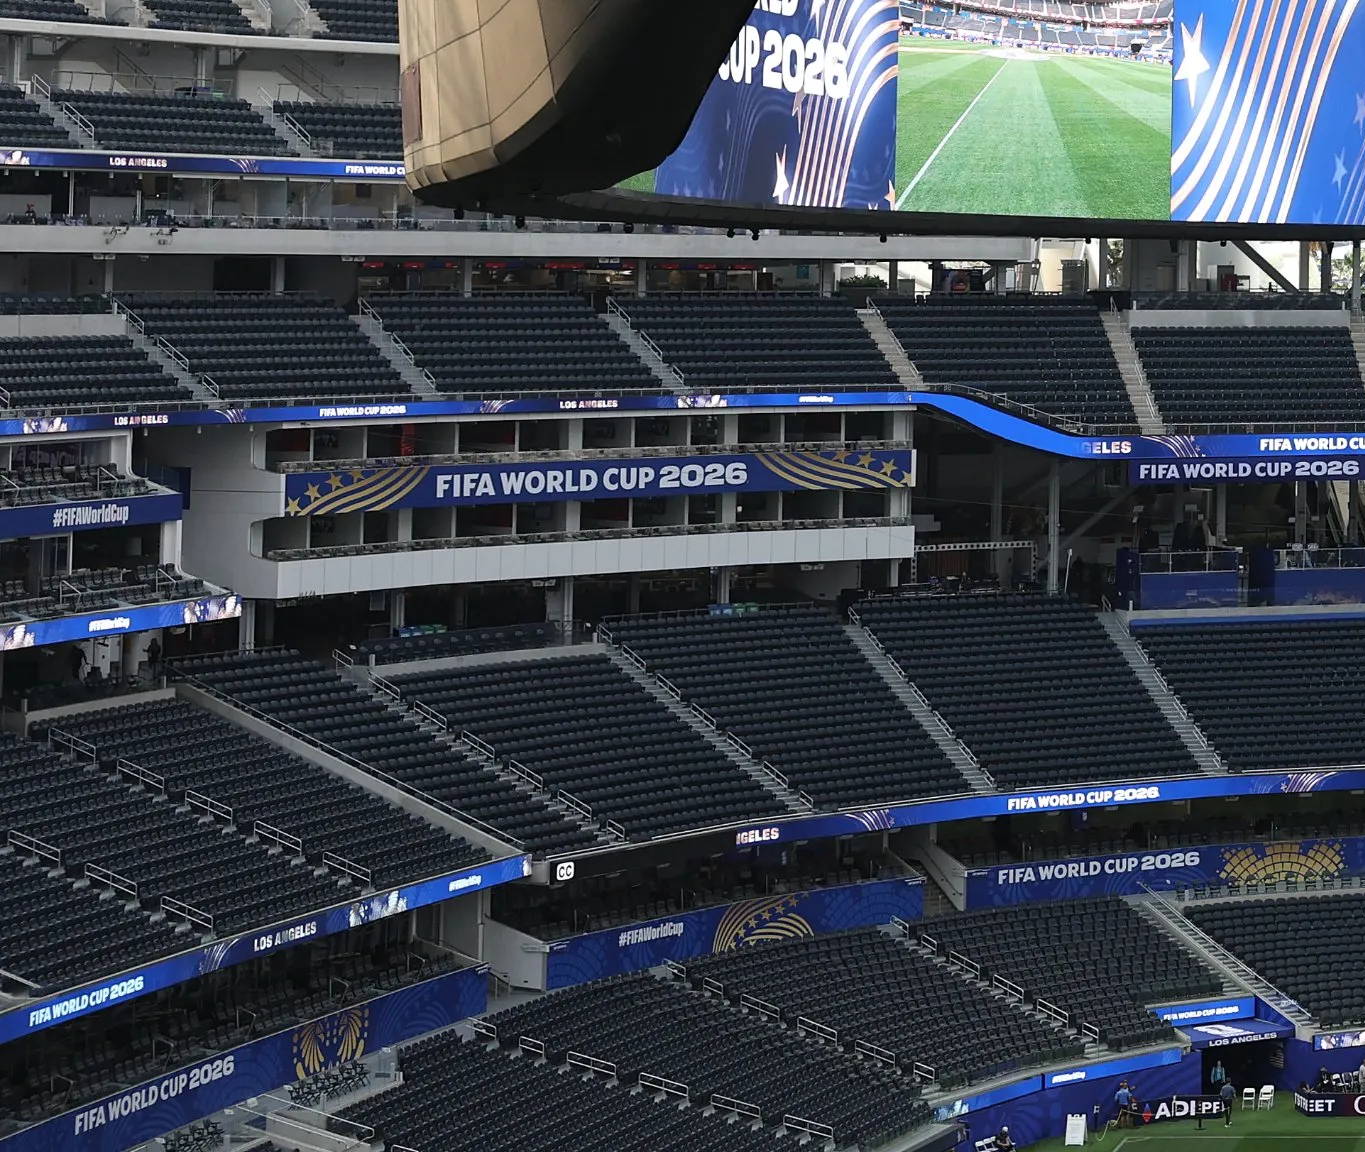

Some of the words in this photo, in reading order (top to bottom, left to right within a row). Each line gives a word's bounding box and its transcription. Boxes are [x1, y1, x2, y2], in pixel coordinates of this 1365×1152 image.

[762, 29, 848, 99] 2026
[109, 156, 126, 167] LOS
[128, 157, 168, 168] ANGELES
[345, 165, 364, 174] FIFA
[364, 166, 396, 175] WORLD
[560, 401, 578, 409] LOS
[580, 399, 618, 408] ANGELES
[114, 417, 128, 426] LOS
[129, 415, 168, 425] ANGELES
[1260, 437, 1291, 451] FIFA
[1294, 437, 1346, 451] WORLD
[436, 472, 495, 498] FIFA
[500, 469, 597, 495] WORLD
[602, 466, 655, 492] CUP
[659, 463, 748, 488] 2026
[1139, 463, 1179, 480] FIFA
[1183, 462, 1251, 479] WORLD
[1254, 461, 1292, 478] CUP
[1295, 460, 1359, 477] 2026
[53, 504, 129, 527] #FIFAWorldCup
[1007, 796, 1036, 810] FIFA
[1038, 793, 1085, 808] WORLD
[1086, 790, 1113, 804] CUP
[1114, 786, 1160, 802] 2026
[736, 827, 779, 845] GELES
[559, 865, 573, 878] CC
[998, 866, 1035, 886] FIFA
[1039, 861, 1100, 882] WORLD
[1103, 857, 1138, 876] CUP
[1141, 851, 1200, 871] 2026
[253, 933, 274, 952] LOS
[275, 921, 317, 946] ANGELES
[619, 921, 684, 948] #FIFAWorldCup
[29, 1007, 52, 1027] FIFA
[52, 995, 88, 1021] WORLD
[89, 988, 110, 1013] CUP
[110, 976, 144, 1005] 2026
[1209, 1038, 1228, 1047] LOS
[1230, 1032, 1277, 1045] ANGELES
[75, 1103, 105, 1136] FIFA
[107, 1083, 158, 1123] WORLD
[160, 1072, 187, 1100] CUP
[189, 1054, 235, 1091] 2026
